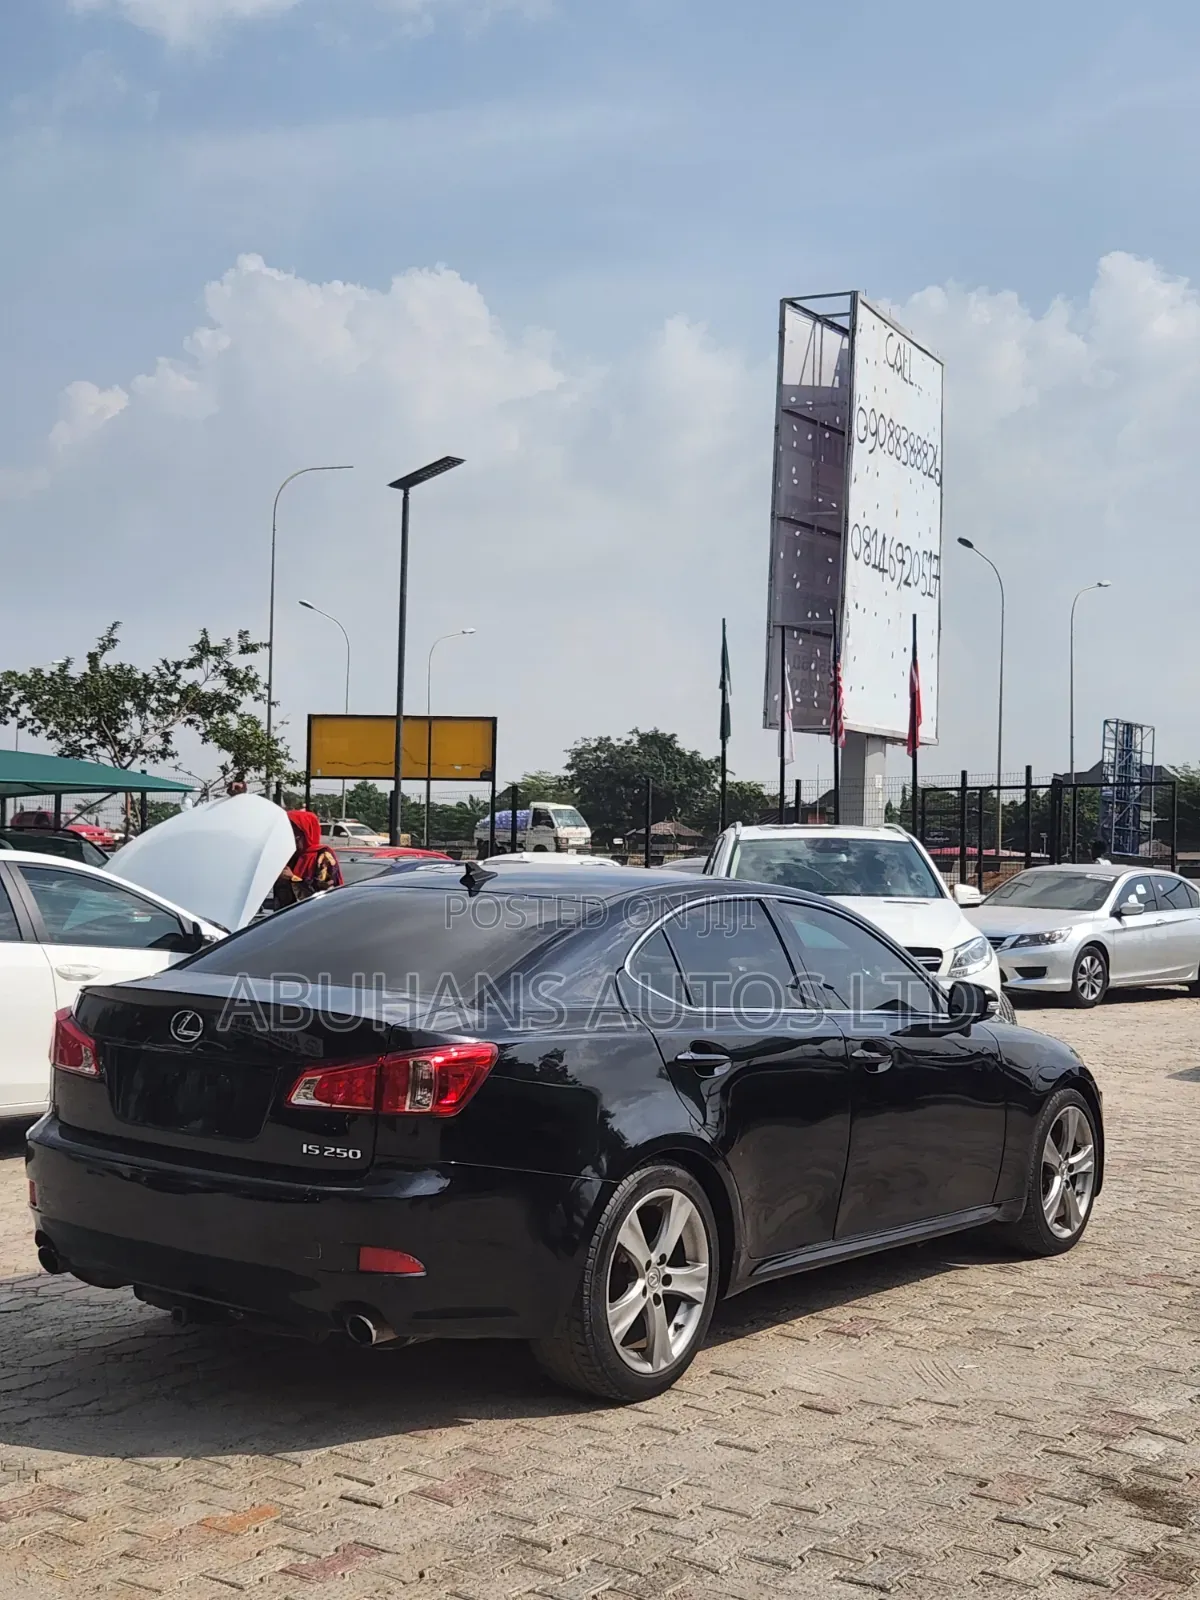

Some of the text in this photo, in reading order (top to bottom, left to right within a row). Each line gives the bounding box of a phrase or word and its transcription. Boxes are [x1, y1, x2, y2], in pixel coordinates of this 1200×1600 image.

[851, 523, 940, 599] 08146920517
[302, 1143, 362, 1159] IS 250
